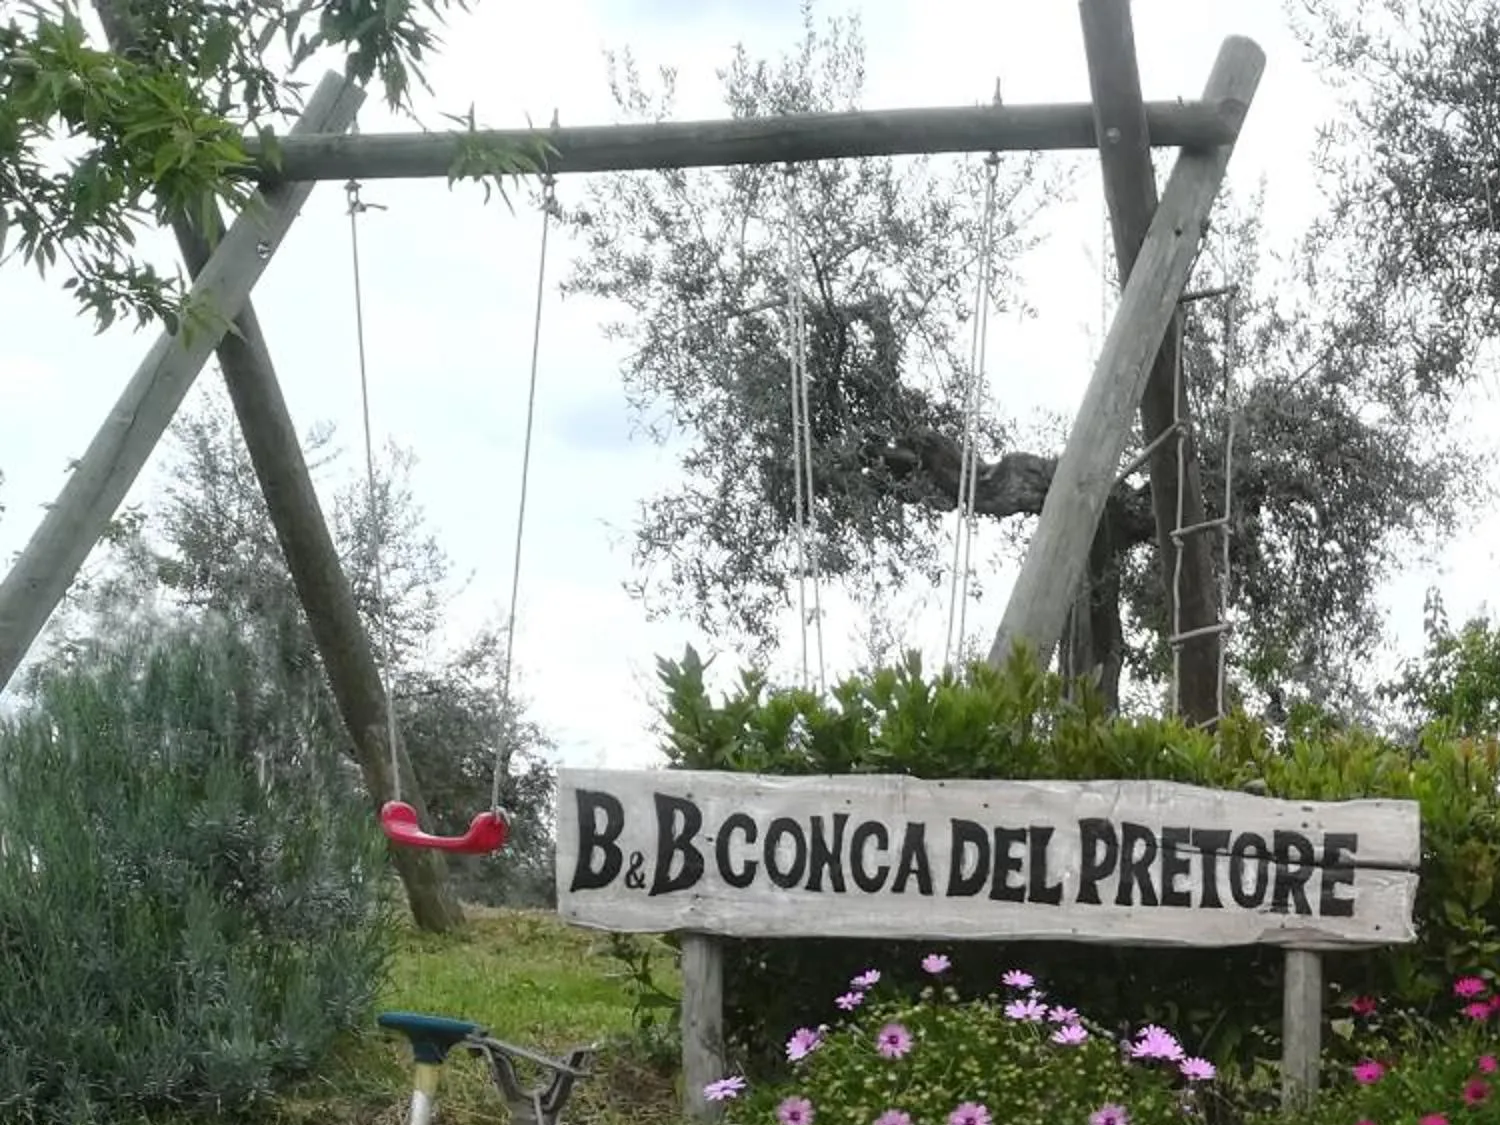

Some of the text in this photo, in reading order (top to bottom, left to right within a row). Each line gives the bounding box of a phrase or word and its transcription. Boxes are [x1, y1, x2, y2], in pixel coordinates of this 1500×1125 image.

[570, 788, 1358, 917] B&B CONCA DEL PRETORE
